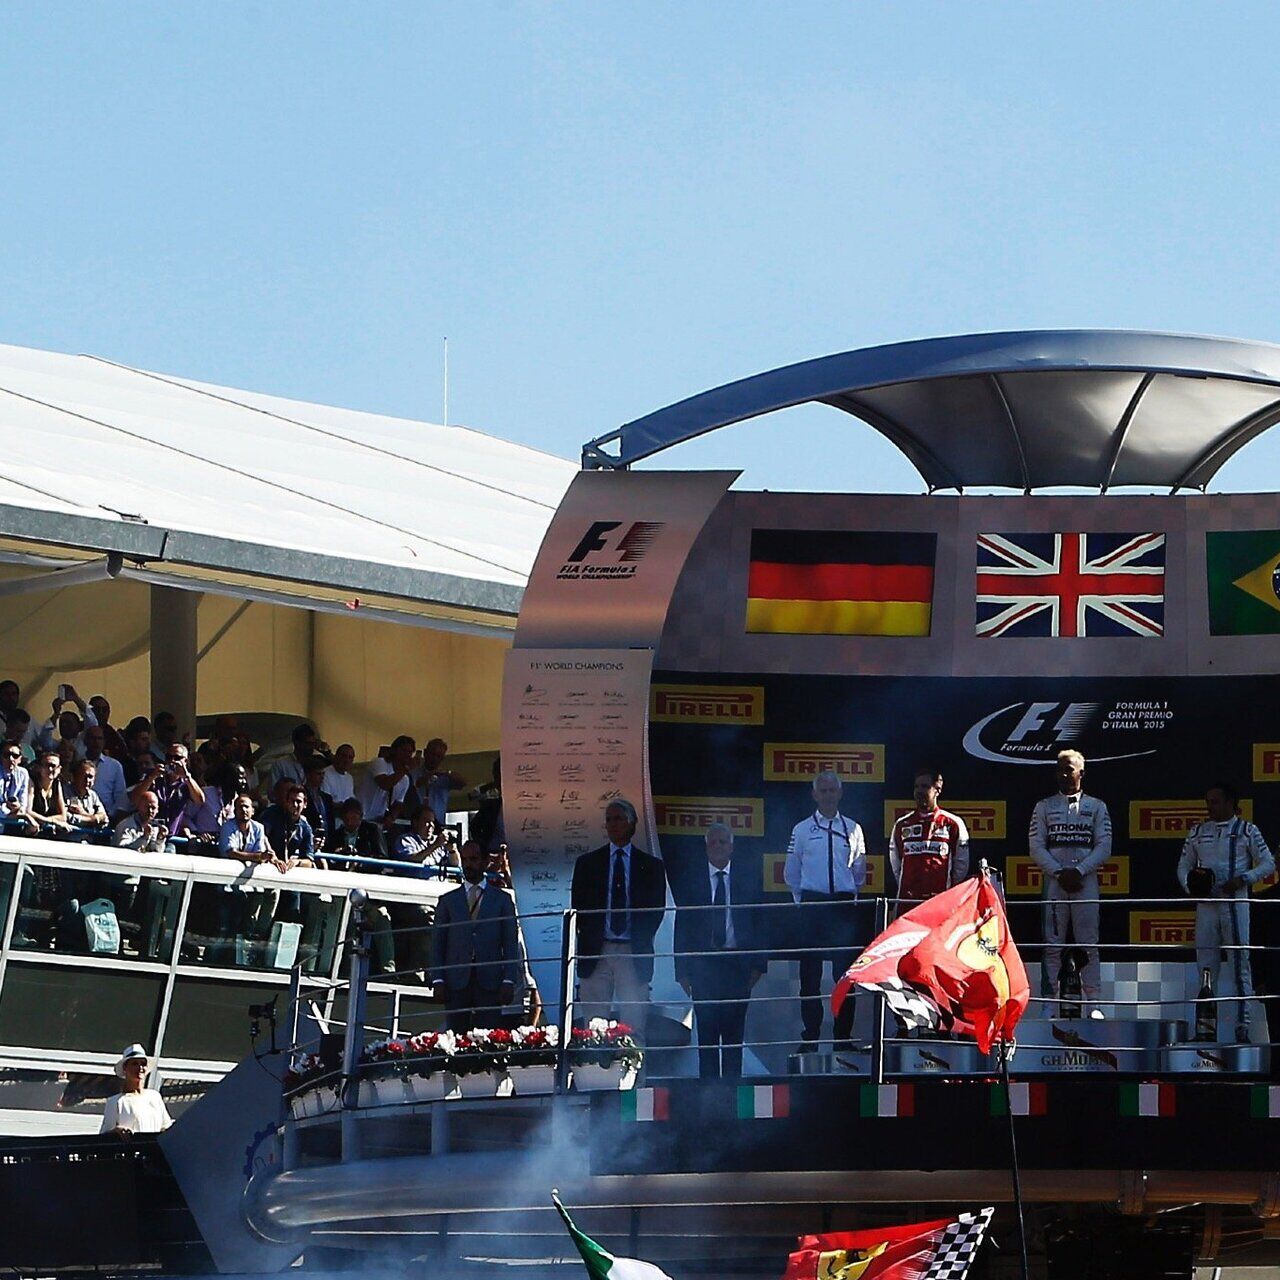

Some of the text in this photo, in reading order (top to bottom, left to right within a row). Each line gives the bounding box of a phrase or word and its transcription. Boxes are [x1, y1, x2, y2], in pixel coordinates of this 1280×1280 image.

[568, 521, 666, 562] F1
[559, 565, 580, 574] FIA
[582, 565, 628, 574] Formula
[544, 662, 573, 671] WORLD
[575, 662, 624, 671] CHAMPIONS
[655, 691, 754, 718] PIRELLI
[1116, 702, 1160, 710] FORMULA
[1108, 711, 1174, 720] GRAN PREMIO
[1006, 702, 1102, 742] F1
[1102, 721, 1165, 729] D'ITALIA 2015
[1000, 743, 1044, 752] Formula
[773, 749, 876, 775] PIRELLI
